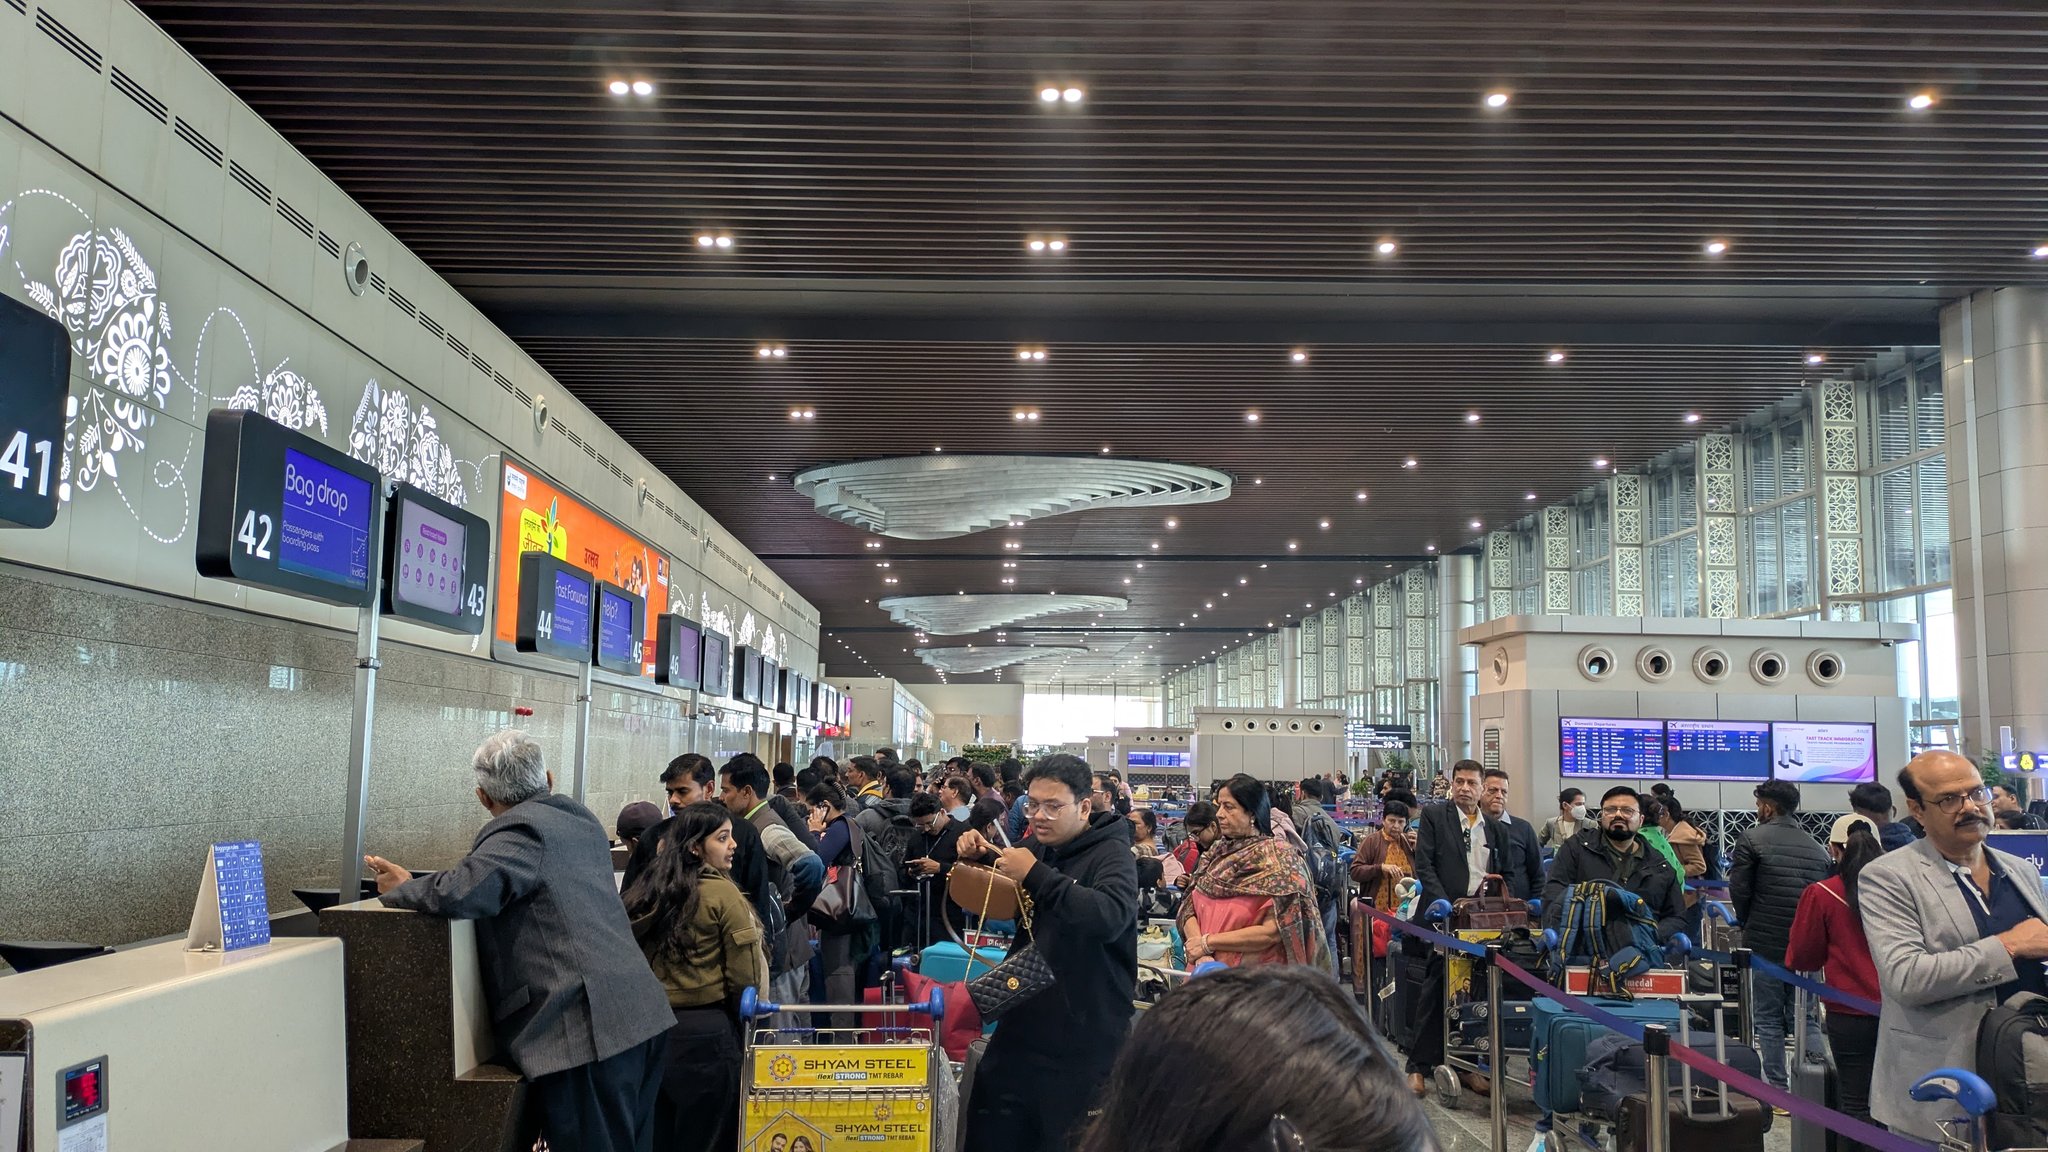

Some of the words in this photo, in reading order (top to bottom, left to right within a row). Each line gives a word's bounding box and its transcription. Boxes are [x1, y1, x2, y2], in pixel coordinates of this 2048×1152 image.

[0, 430, 52, 497] 41
[285, 463, 315, 507] Bag
[317, 478, 348, 517] drop
[238, 509, 273, 560] 42
[282, 519, 313, 539] Passengers
[313, 531, 325, 542] with
[282, 533, 307, 553] boarding
[306, 542, 320, 553] pass
[584, 548, 599, 570] उत्सव
[467, 583, 485, 617] 43
[602, 599, 619, 622] Help?
[537, 610, 552, 640] 44
[632, 641, 643, 664] 45
[669, 654, 679, 675] 46
[1383, 741, 1404, 749] 59-76
[804, 1059, 860, 1070] SHYAM
[865, 1059, 915, 1069] STEEL
[835, 1072, 866, 1080] STRONG
[869, 1072, 883, 1080] TMT
[883, 1072, 904, 1080] REBAR
[835, 1124, 881, 1133] SHYAM
[884, 1124, 925, 1133] STEEL
